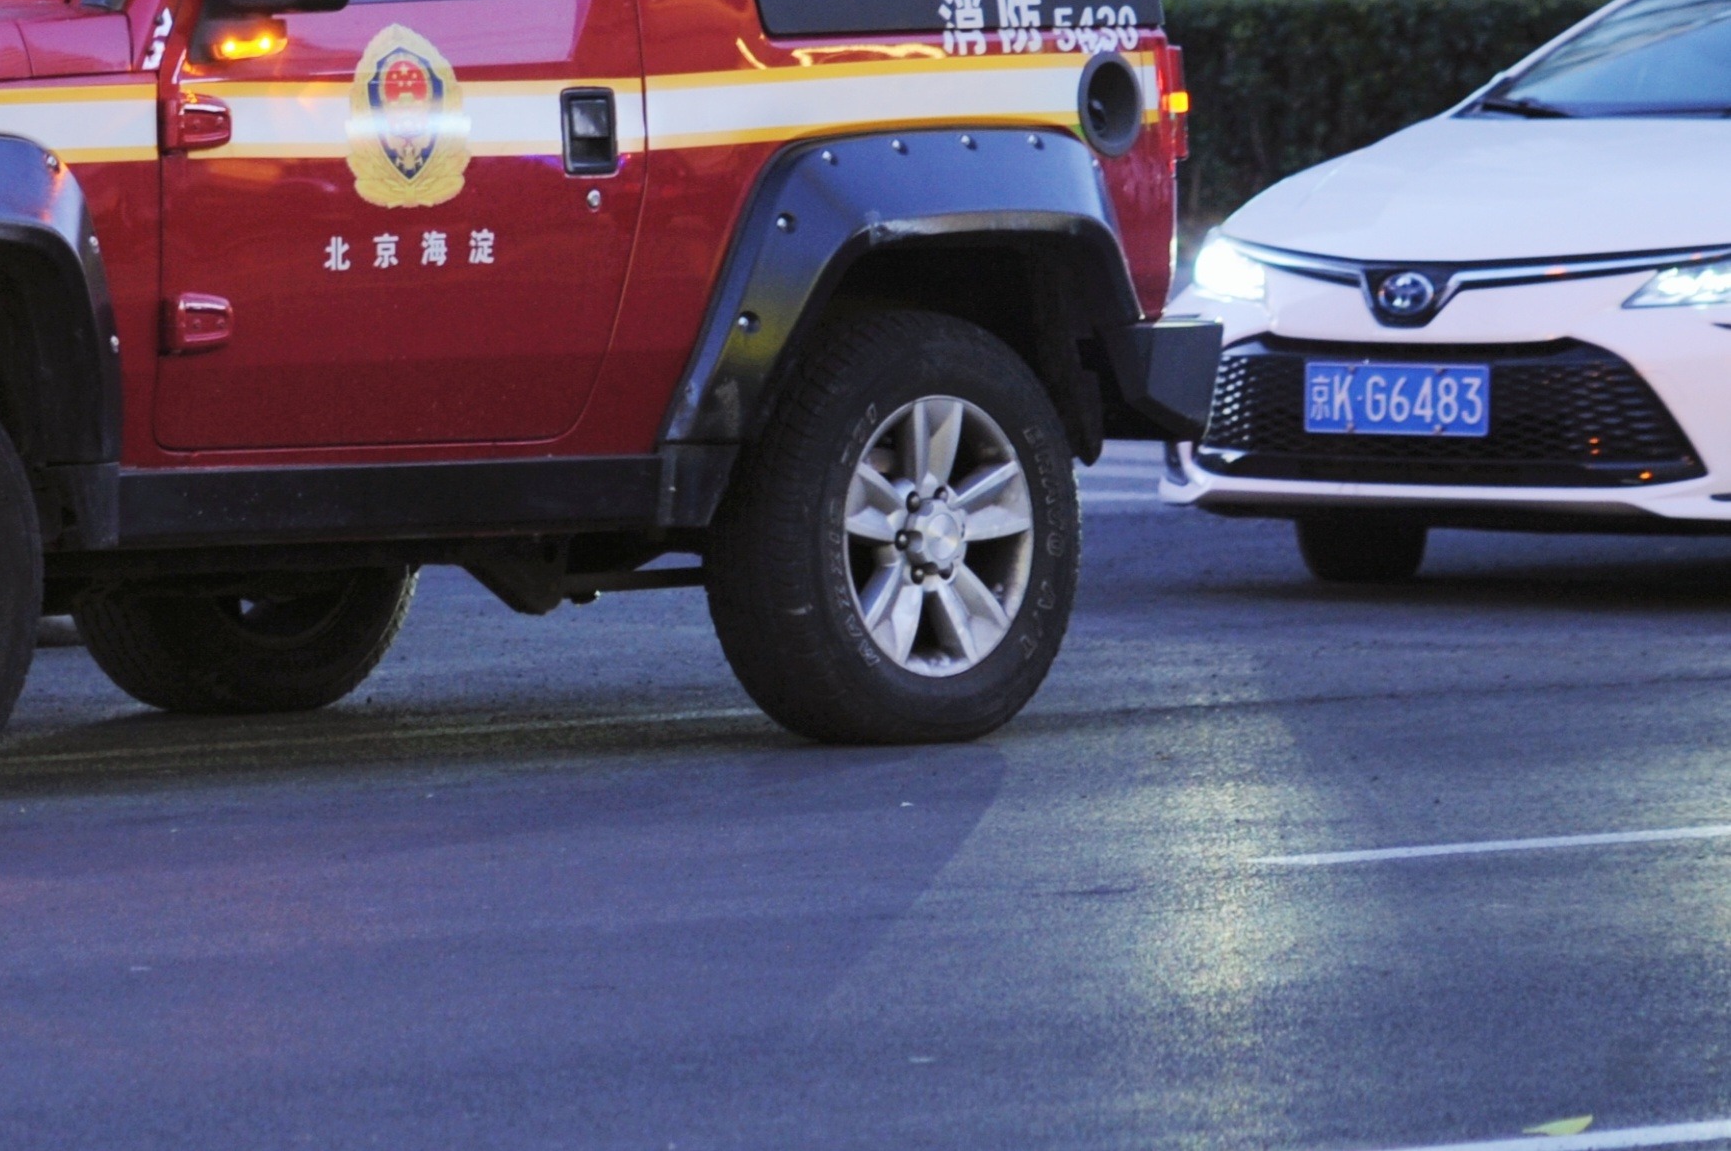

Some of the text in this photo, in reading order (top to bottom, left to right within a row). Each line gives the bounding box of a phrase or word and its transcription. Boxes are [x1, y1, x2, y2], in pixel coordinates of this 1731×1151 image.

[1053, 5, 1140, 54] 5430
[324, 228, 496, 272] 北京海淀
